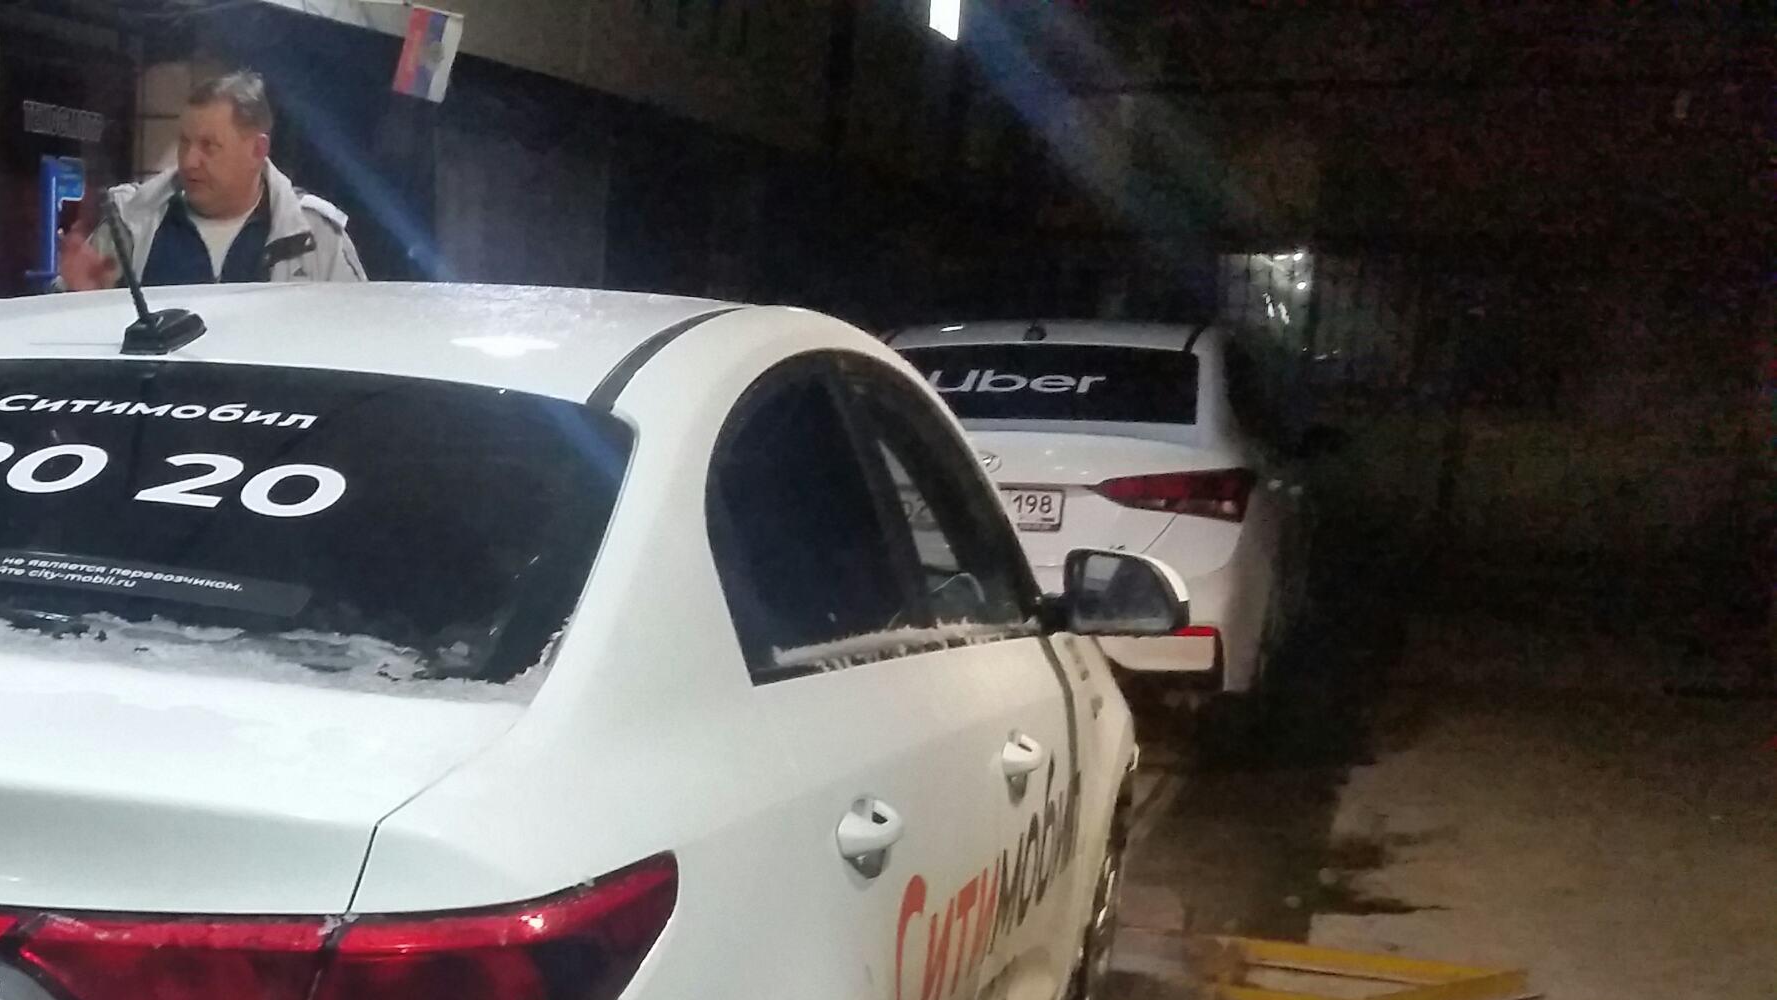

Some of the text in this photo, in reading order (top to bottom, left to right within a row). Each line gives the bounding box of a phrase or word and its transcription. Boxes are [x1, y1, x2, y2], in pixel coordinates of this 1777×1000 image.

[927, 369, 1107, 393] Uber
[133, 453, 347, 518] 20
[1012, 494, 1053, 515] 198
[2, 557, 26, 566] не
[28, 559, 106, 574] является
[29, 568, 137, 588] city-mobil.ru
